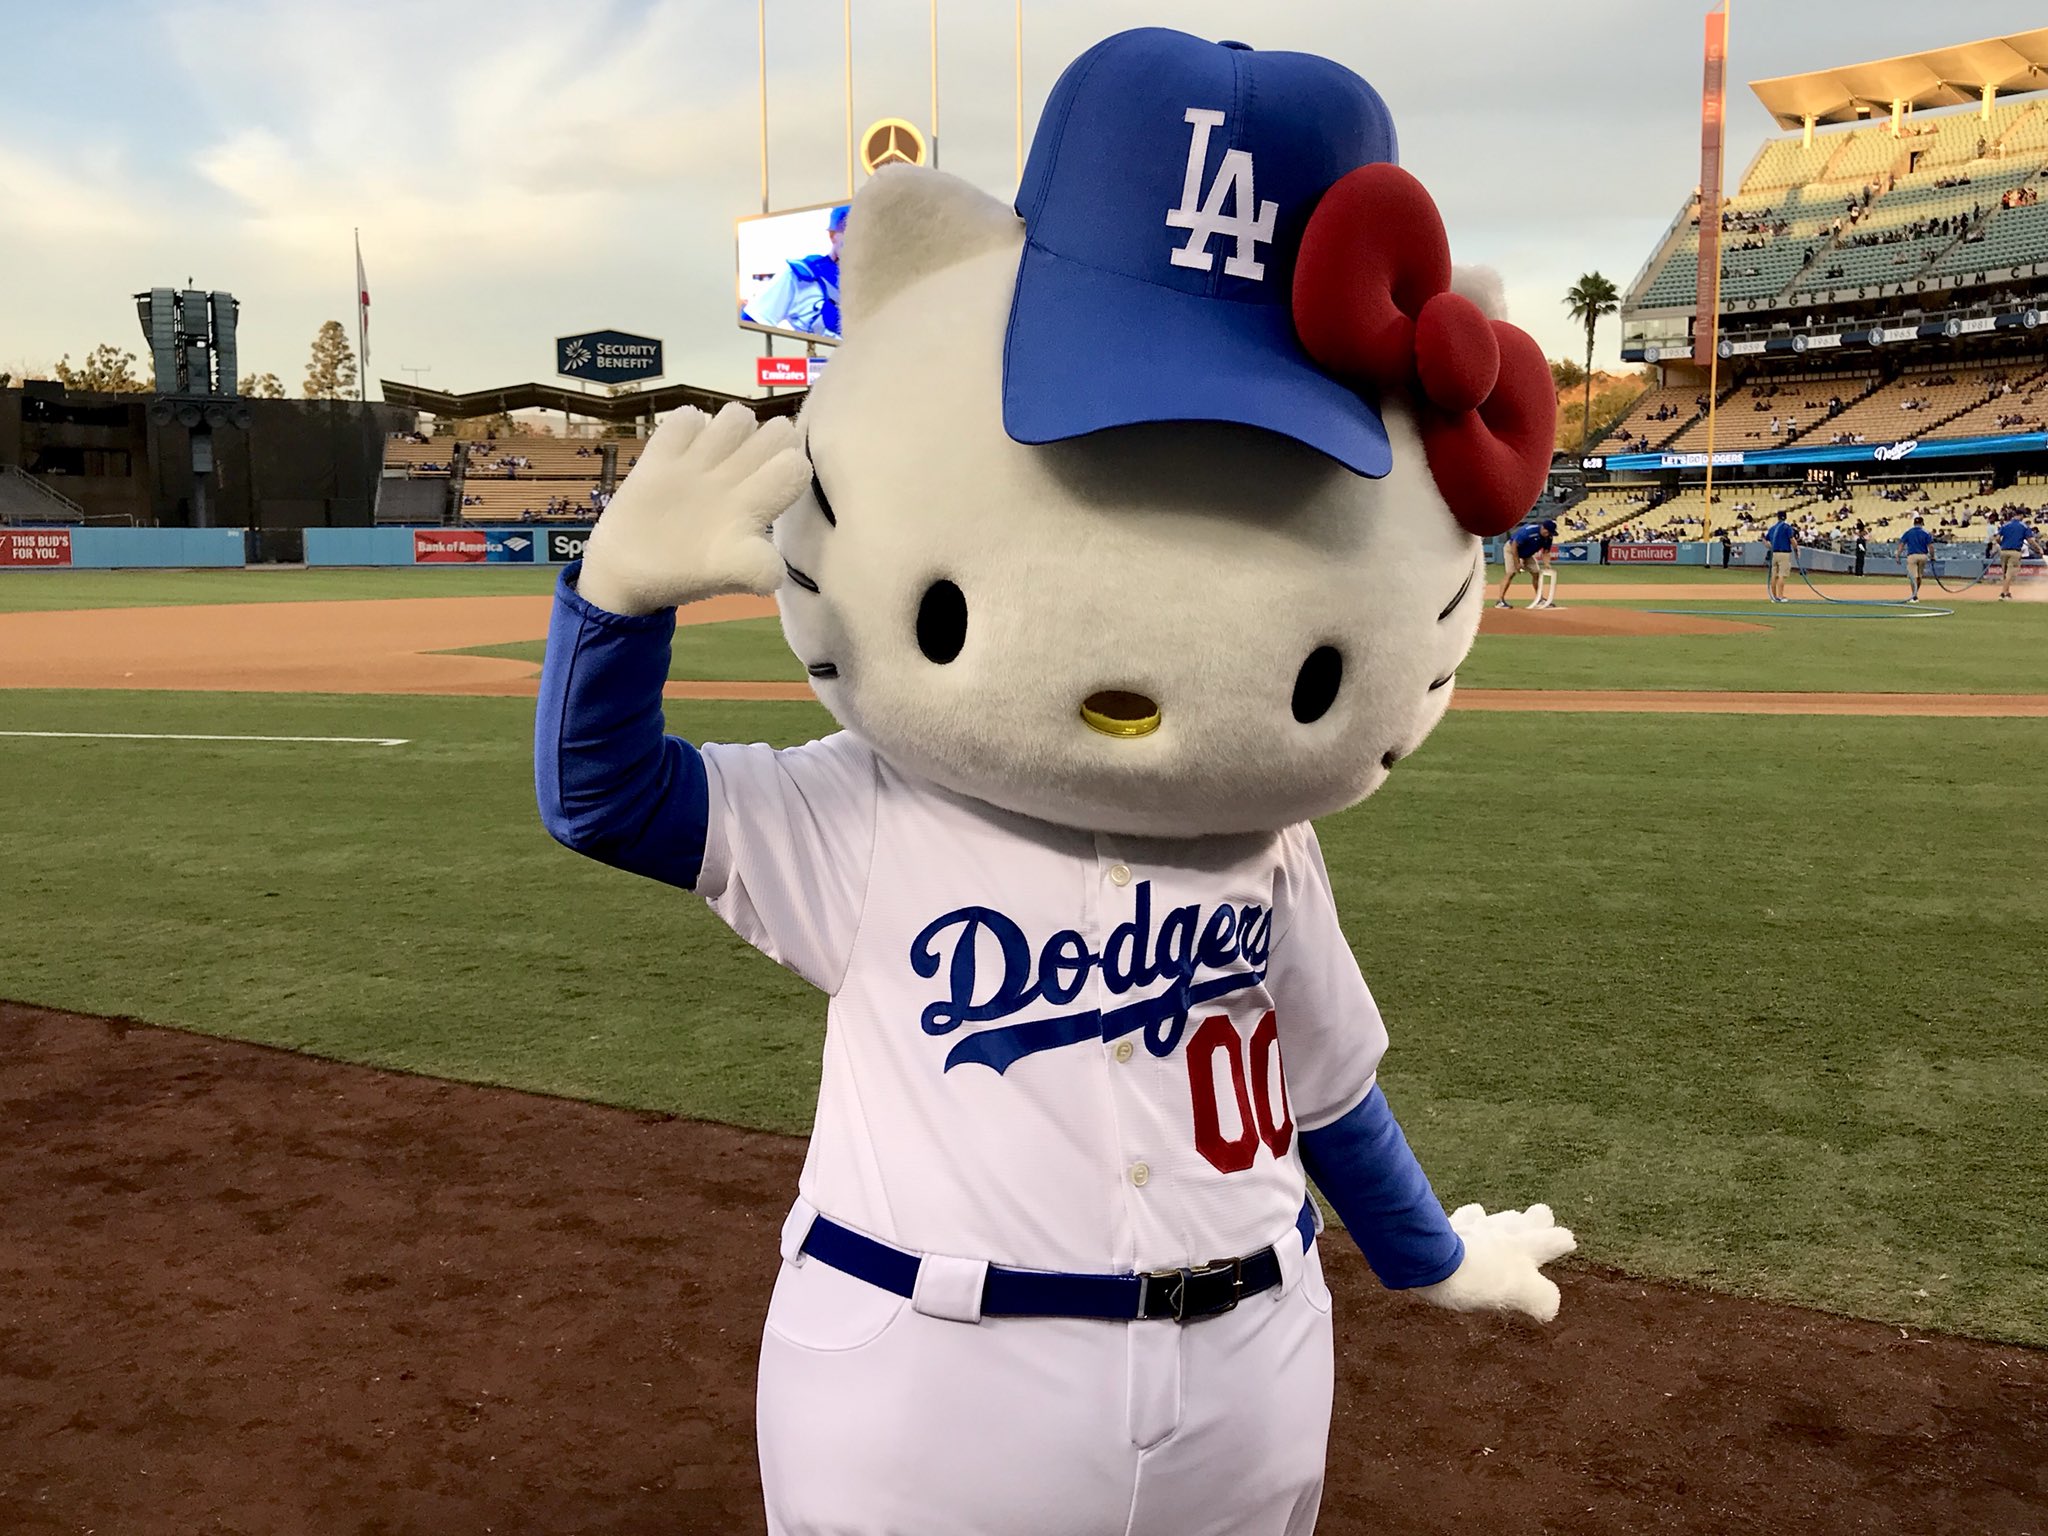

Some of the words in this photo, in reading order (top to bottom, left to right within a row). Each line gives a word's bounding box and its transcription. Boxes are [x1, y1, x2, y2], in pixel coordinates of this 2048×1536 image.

[1166, 107, 1279, 281] LA
[1727, 291, 1836, 312] DODGER
[1858, 271, 1987, 299] STADIUM
[596, 342, 656, 355] SECURITY
[776, 362, 791, 372] Fly
[761, 369, 805, 381] Emirates
[11, 535, 36, 547] THIS
[38, 535, 69, 547] BUD'S
[417, 541, 445, 553] Bank
[446, 541, 459, 552] of
[460, 541, 504, 553] America
[12, 548, 33, 559] FOR
[35, 548, 60, 559] YOU.
[1611, 548, 1629, 561] Fly
[1630, 547, 1674, 559] Emirates
[910, 880, 1273, 1065] Dodgers
[1187, 1010, 1294, 1174] 00
